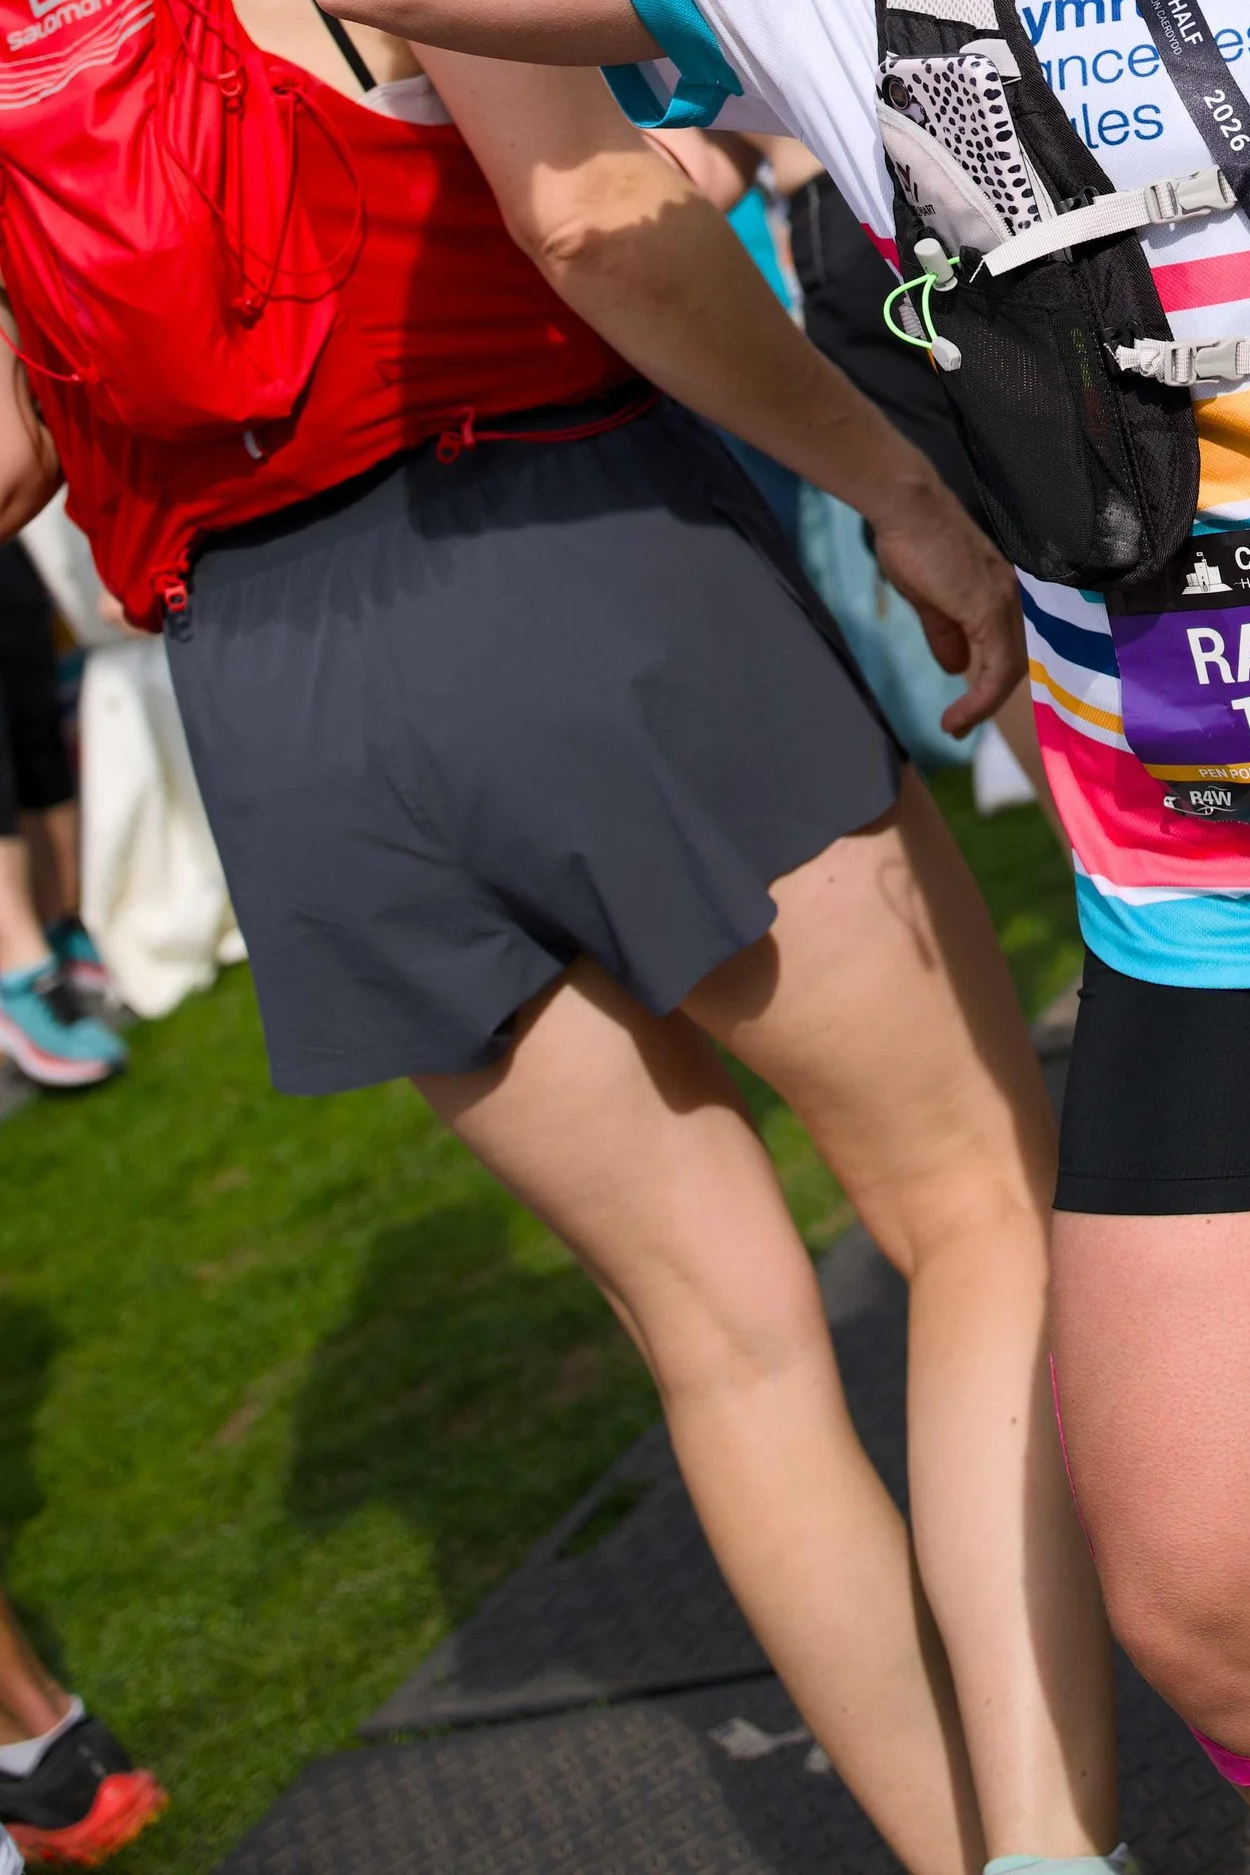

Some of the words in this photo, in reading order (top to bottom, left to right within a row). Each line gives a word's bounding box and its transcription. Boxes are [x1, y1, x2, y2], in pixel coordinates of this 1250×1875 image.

[1157, 9, 1183, 56] CAERDYDD
[1203, 89, 1250, 152] 2026
[1199, 765, 1229, 779] PEN
[1189, 789, 1232, 807] R4W
